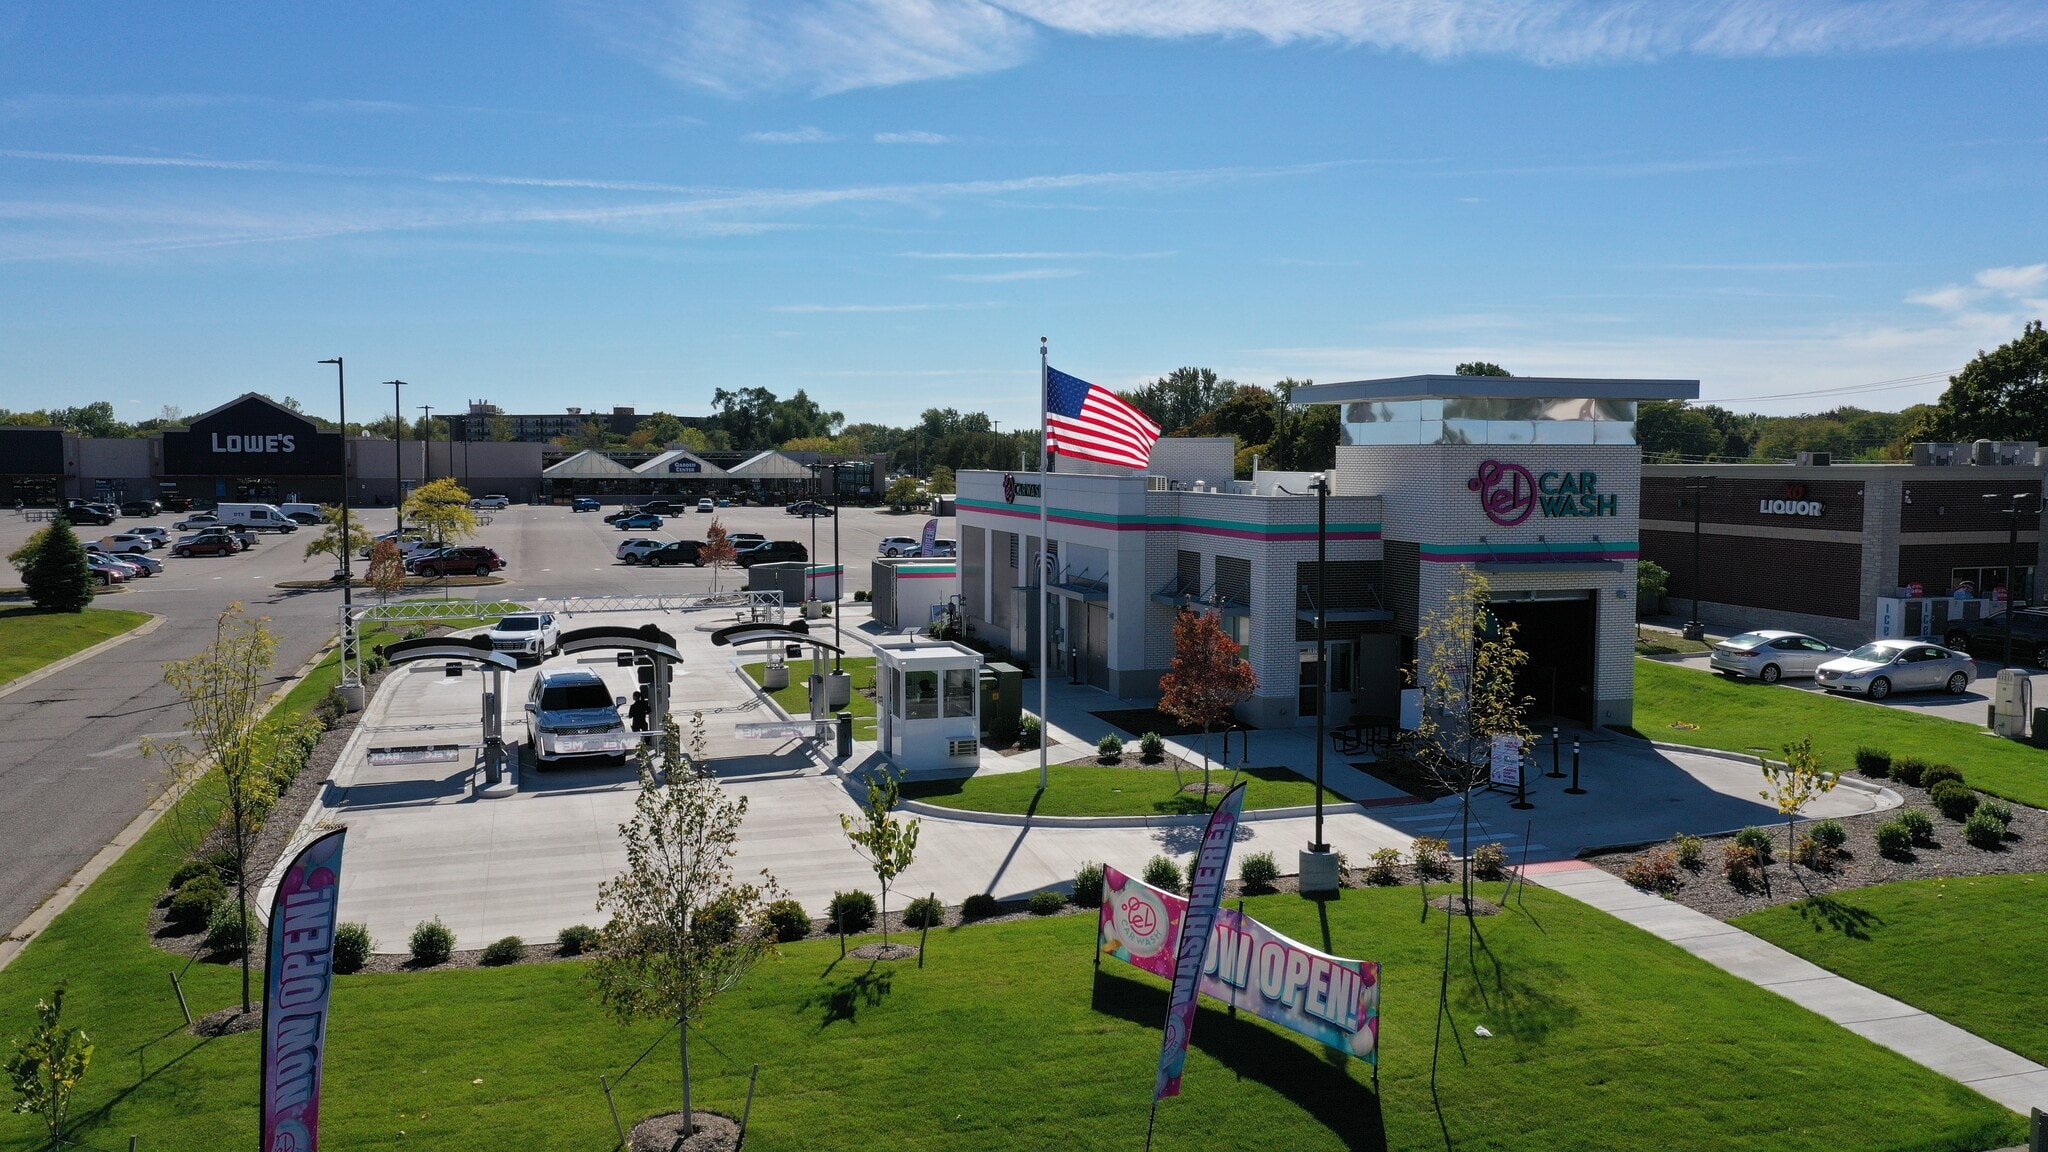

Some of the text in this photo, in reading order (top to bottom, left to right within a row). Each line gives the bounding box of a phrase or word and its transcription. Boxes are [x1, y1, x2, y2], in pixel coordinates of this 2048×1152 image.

[212, 432, 296, 453] LOWE'S
[1539, 471, 1598, 495] CAR
[1539, 493, 1618, 518] WASH
[1759, 499, 1823, 517] LIQUOR
[1121, 919, 1162, 946] CAR WASH
[1169, 913, 1213, 1007] WASH
[1259, 940, 1362, 1035] OPEN!
[276, 887, 334, 1116] NOW OPEN!
